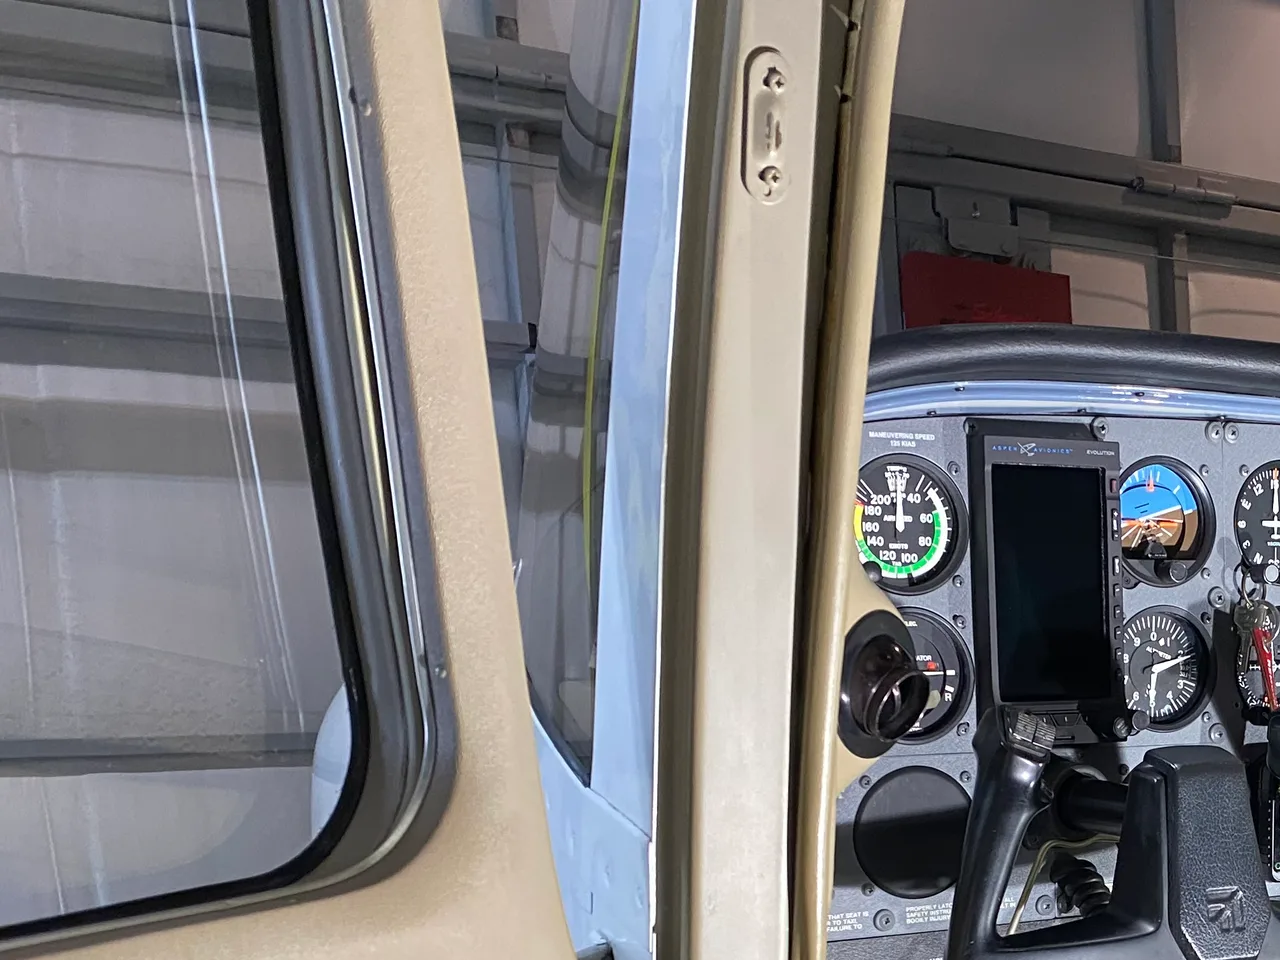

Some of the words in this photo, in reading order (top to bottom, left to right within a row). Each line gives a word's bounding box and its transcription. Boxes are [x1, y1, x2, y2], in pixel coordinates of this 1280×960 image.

[869, 431, 914, 440] MANEUVERING
[914, 433, 935, 441] SPEED
[871, 494, 890, 505] 200
[907, 493, 921, 504] 40
[865, 505, 882, 516] 180
[920, 513, 933, 523] 60
[863, 522, 879, 532] 160
[867, 536, 884, 546] 140
[919, 537, 932, 547] 80
[880, 550, 896, 560] 120
[901, 553, 918, 563] 100
[1150, 632, 1157, 641] 0
[1133, 637, 1141, 647] 9
[1123, 654, 1129, 663] 8
[1177, 679, 1184, 689] 3
[945, 693, 952, 701] R
[1133, 691, 1139, 700] 6
[1166, 690, 1173, 699] 4
[906, 904, 937, 912] PROPERLY
[845, 911, 862, 919] SEAT
[929, 914, 951, 922] INJURY
